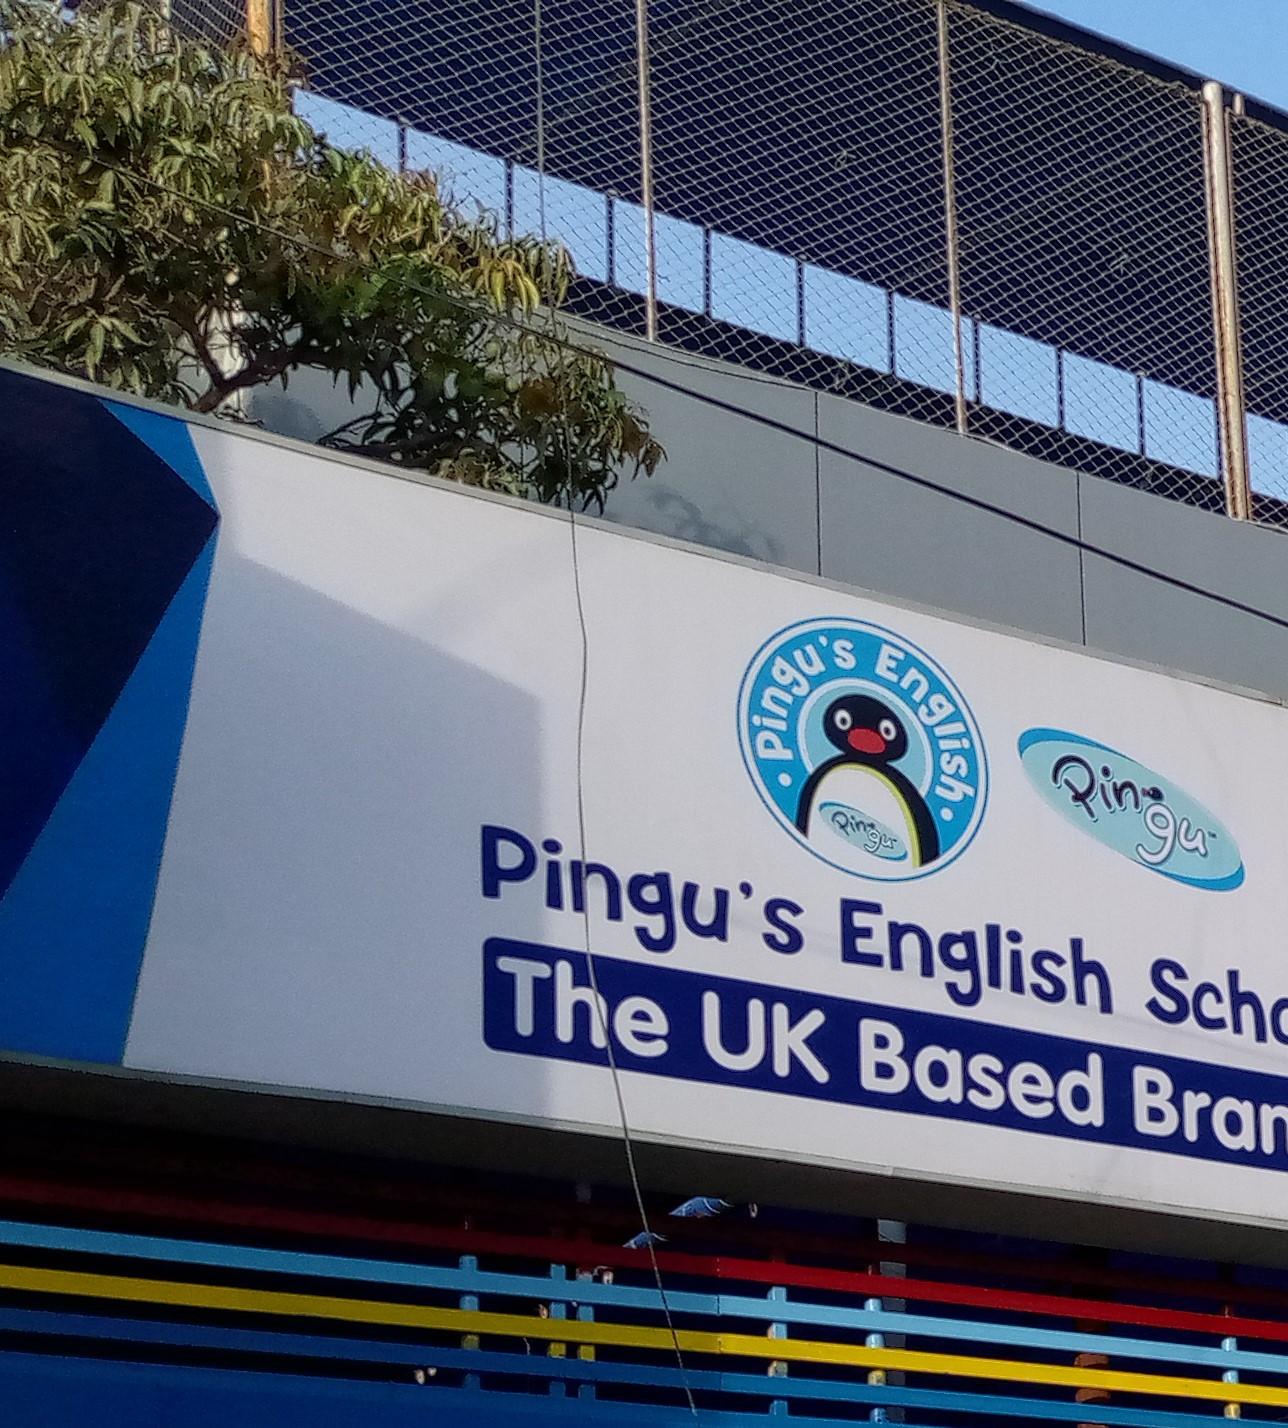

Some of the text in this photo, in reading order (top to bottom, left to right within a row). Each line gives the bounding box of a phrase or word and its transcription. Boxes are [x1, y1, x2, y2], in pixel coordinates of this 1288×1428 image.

[754, 634, 976, 804] Pingu's English
[1052, 754, 1208, 865] Pingu
[481, 825, 804, 952] Pingu's
[840, 898, 1112, 1014] English
[496, 957, 669, 1056] The
[703, 990, 830, 1084] UK
[859, 1021, 1104, 1127] Based
